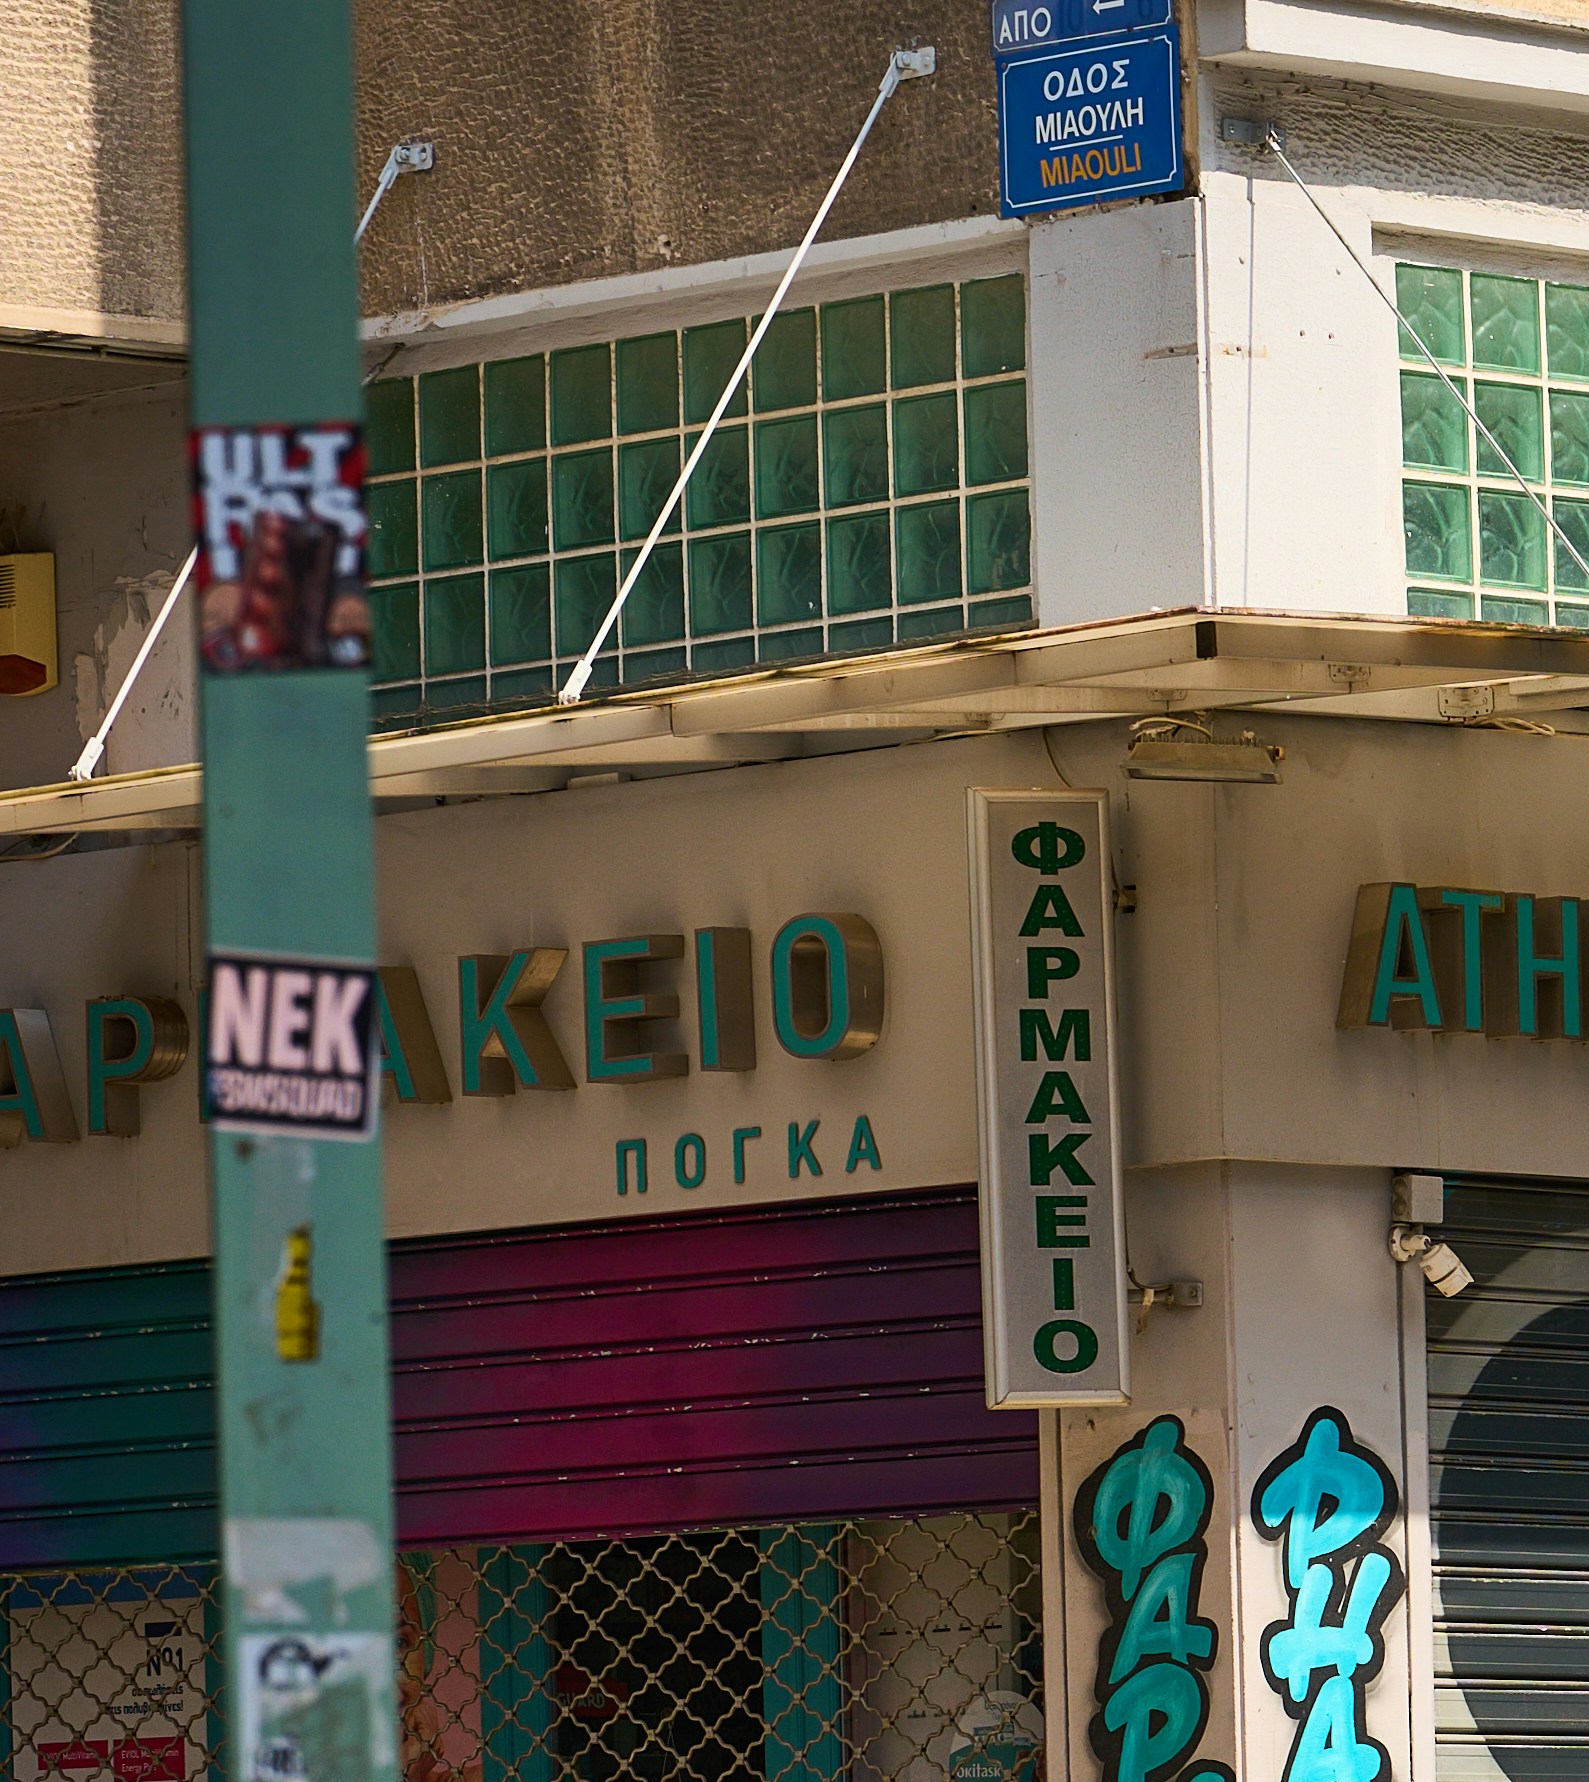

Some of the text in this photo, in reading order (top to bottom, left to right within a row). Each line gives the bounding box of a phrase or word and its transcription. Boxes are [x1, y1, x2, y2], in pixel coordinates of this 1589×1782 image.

[999, 7, 1051, 44] ΑΠΟ
[1043, 59, 1130, 101] ΟΔΟΣ
[1035, 97, 1144, 144] ΜΙΑΟΥΛΗ
[1040, 143, 1142, 188] MIAOULI
[0, 911, 880, 1146] ΑΡΚΕΙΟ
[211, 964, 370, 1075] NEK
[1009, 820, 1098, 1374] ΦΑΡΜΑΚΕΙΟ
[616, 1116, 882, 1195] ΠΟΓΚΑ
